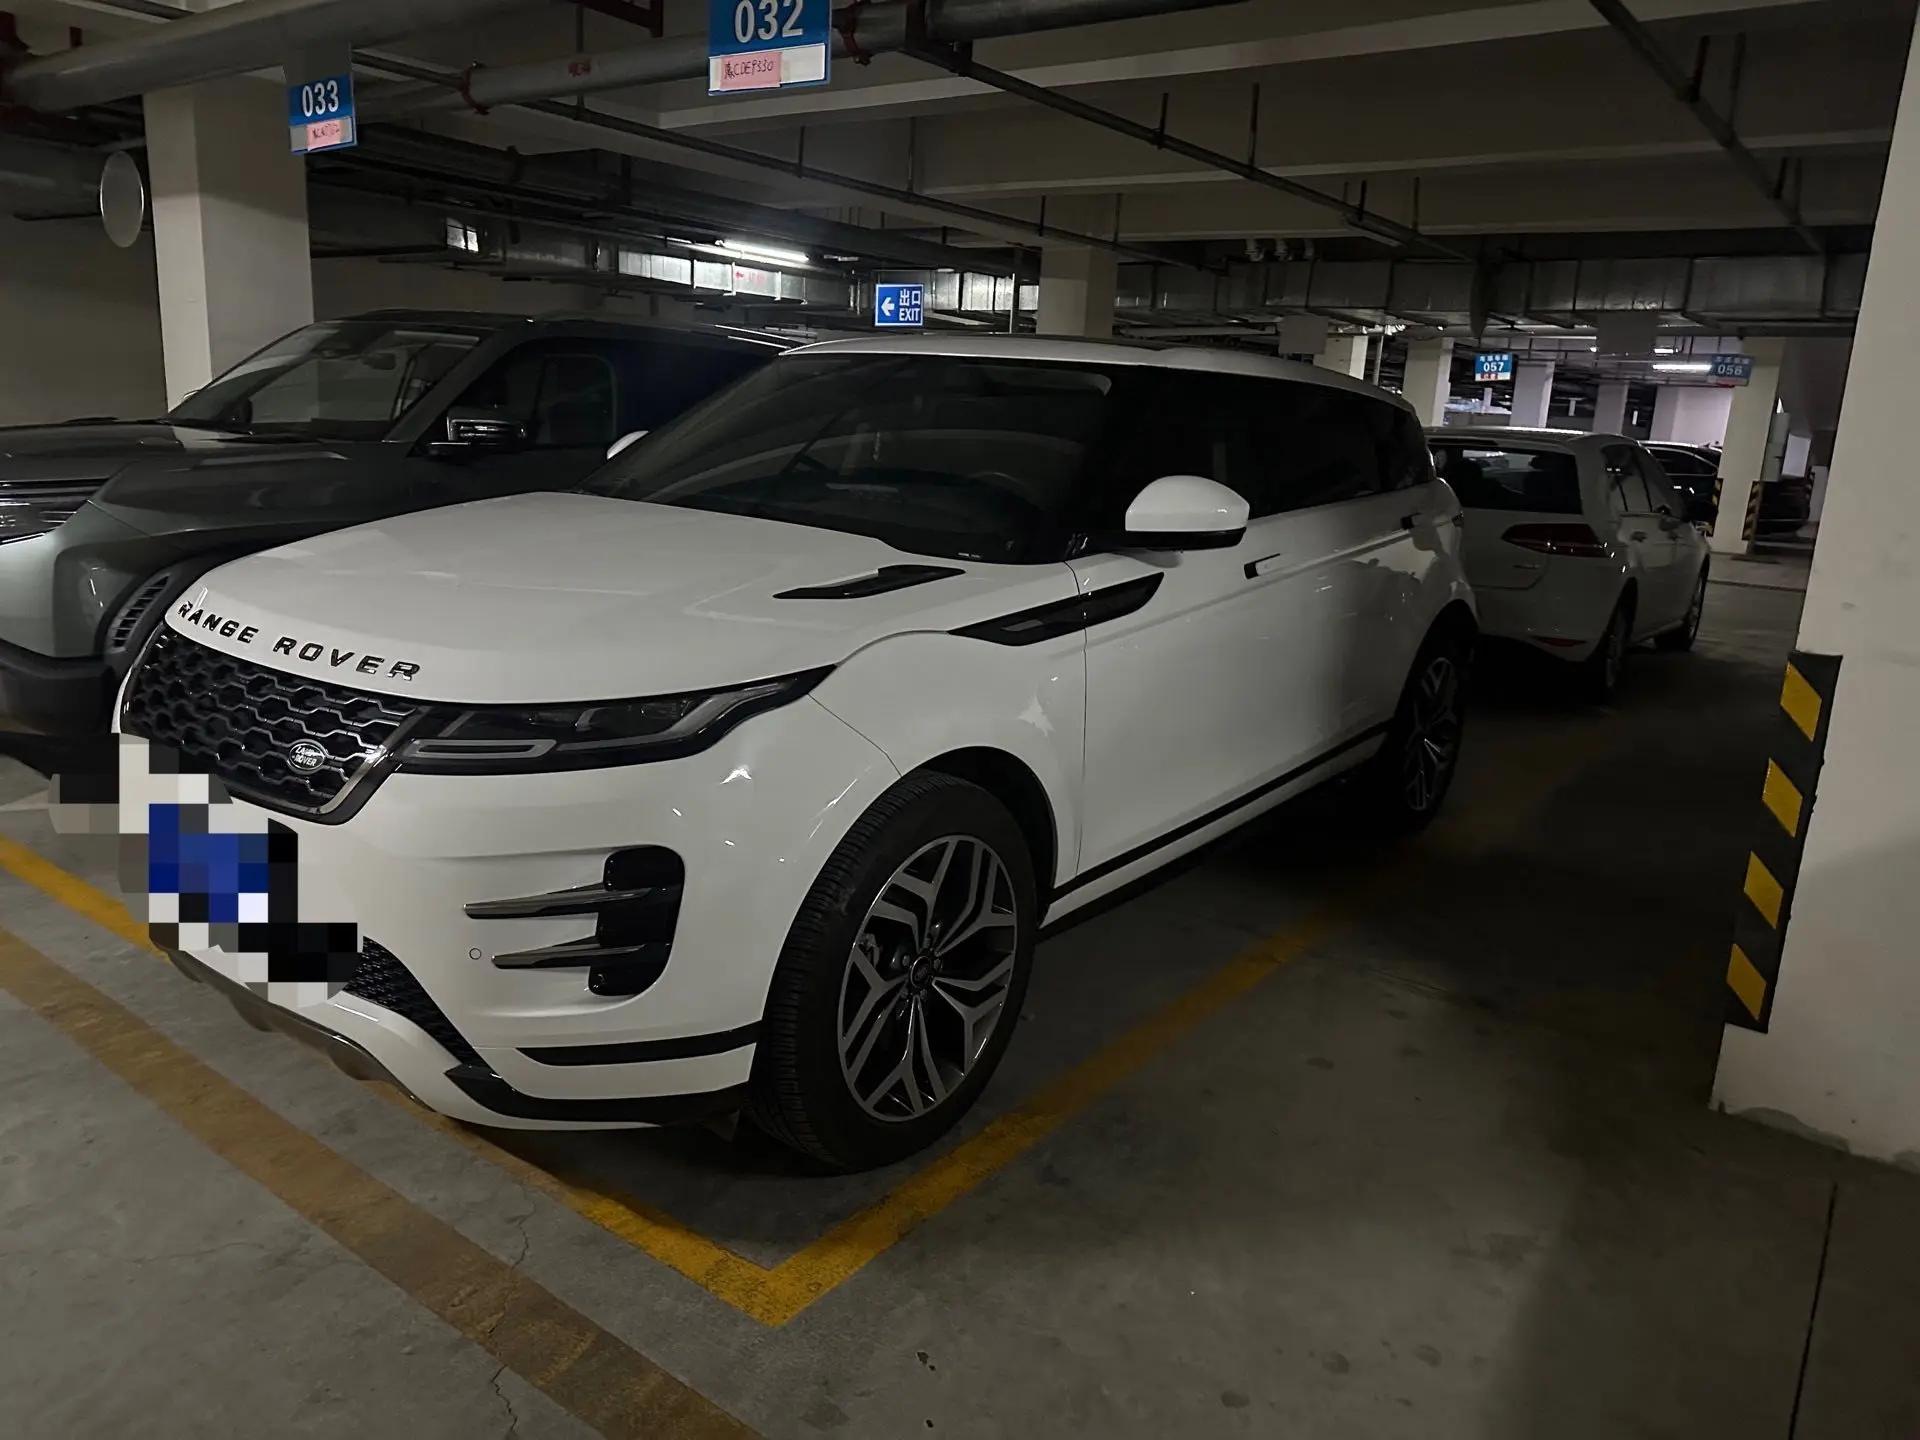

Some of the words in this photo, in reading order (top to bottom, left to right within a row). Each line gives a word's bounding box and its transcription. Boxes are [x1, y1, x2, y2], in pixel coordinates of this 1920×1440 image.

[735, 0, 803, 43] 032
[302, 80, 339, 117] 033
[899, 289, 920, 306] 出口
[899, 308, 920, 321] EXIT
[1483, 362, 1504, 372] 057
[178, 600, 259, 644] RANGE
[272, 636, 421, 681] ROVER
[294, 754, 317, 767] ROVER
